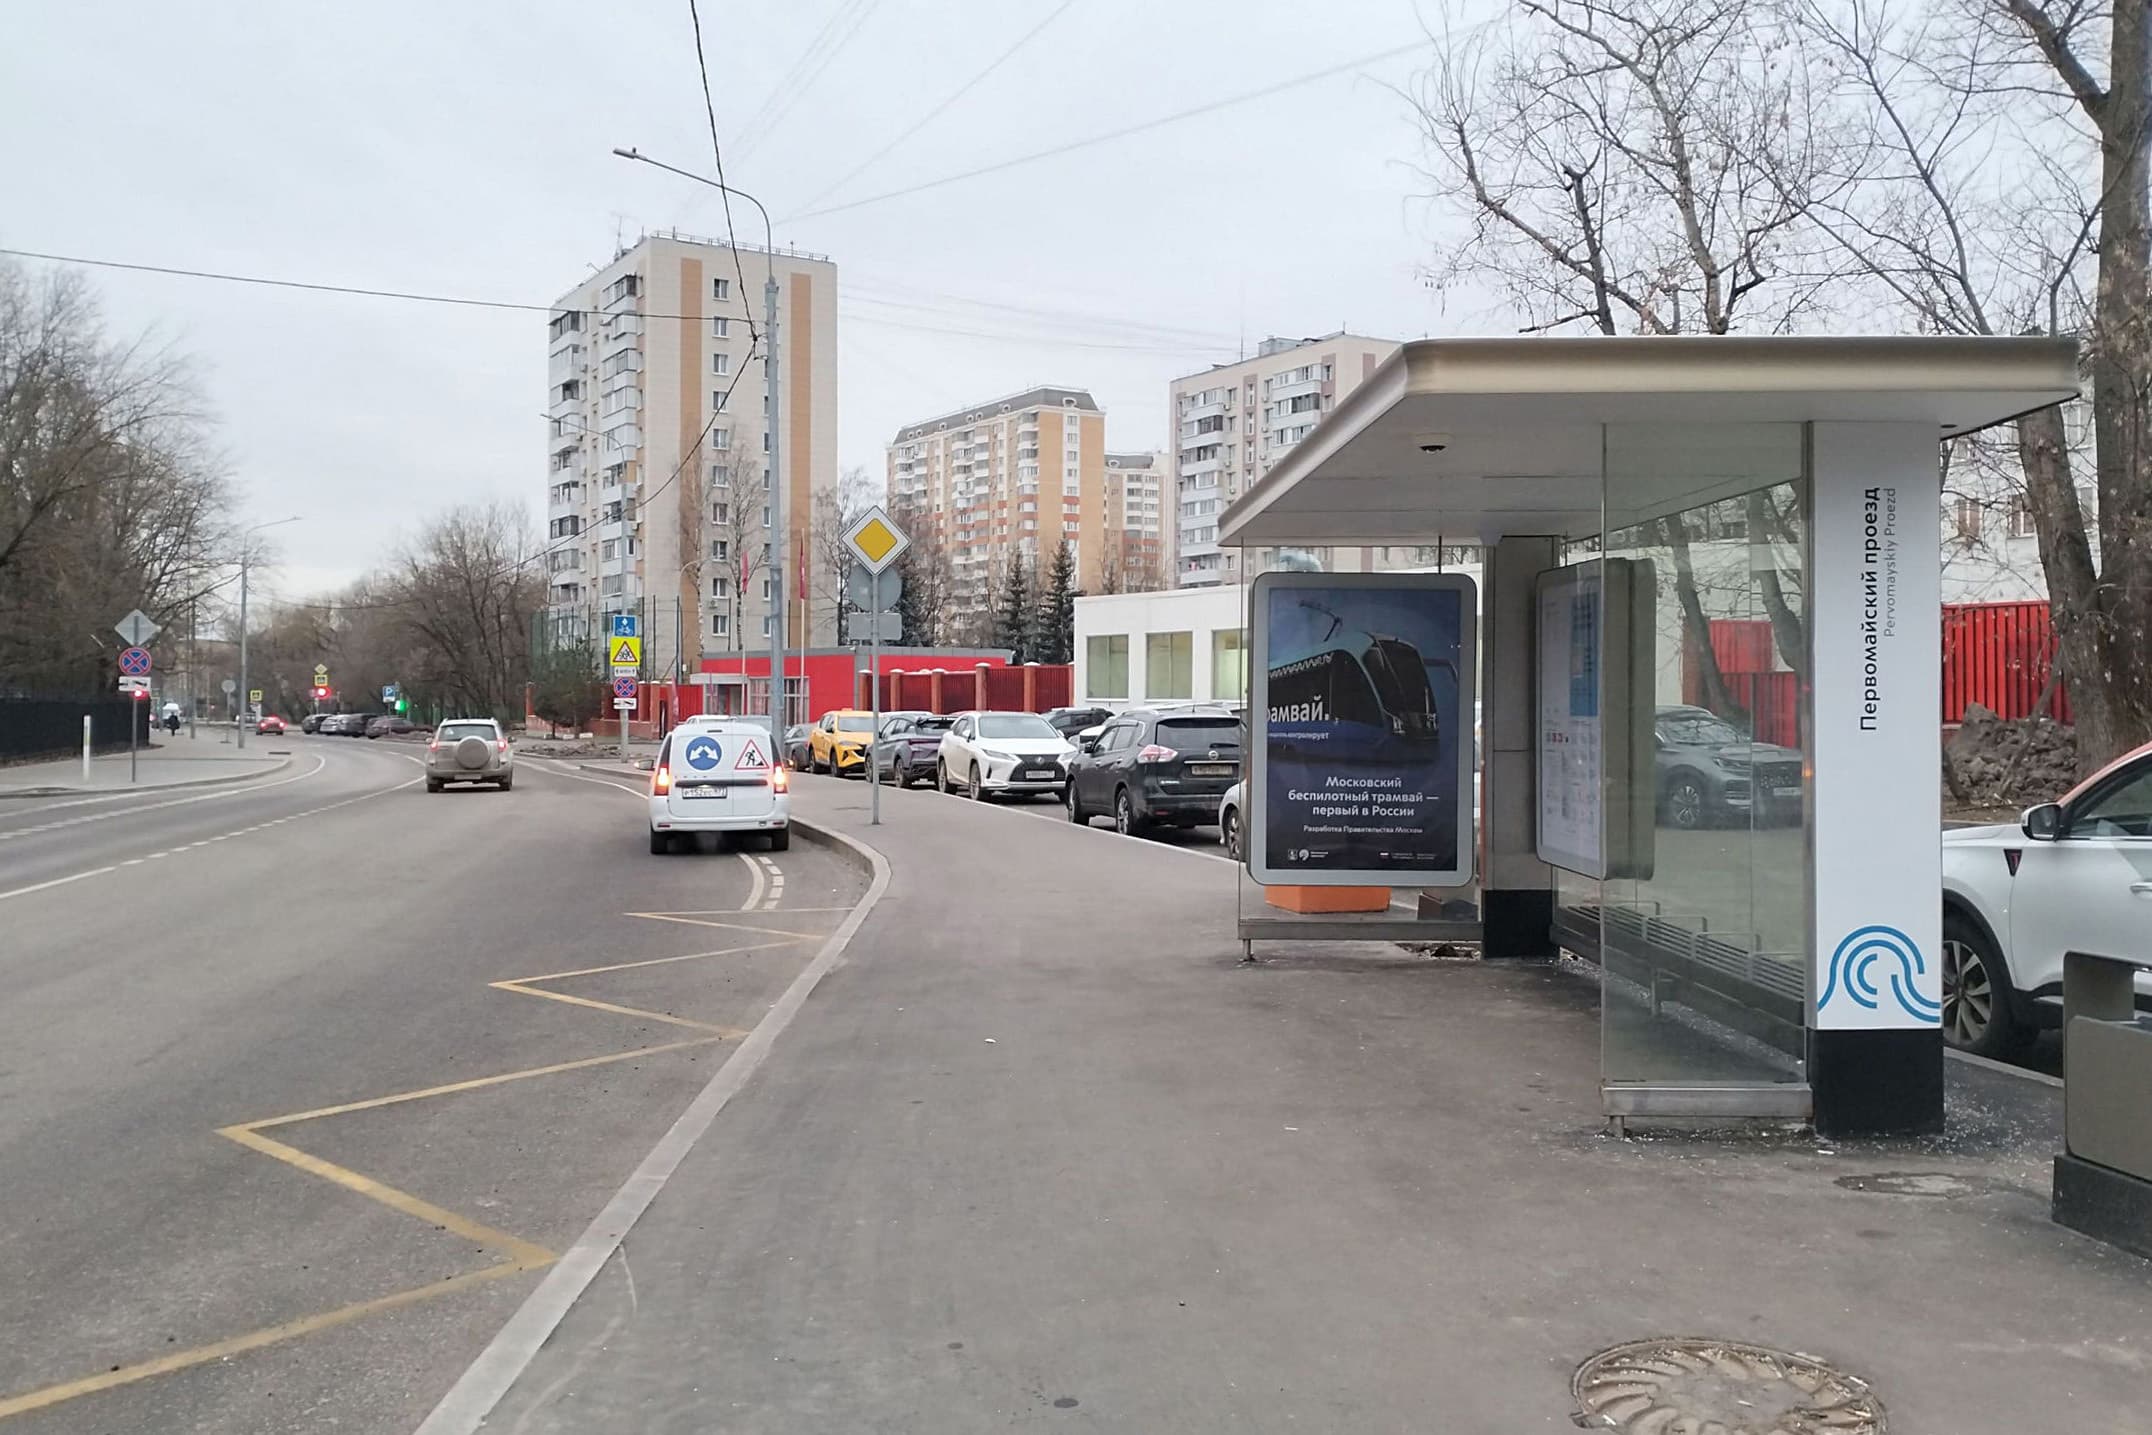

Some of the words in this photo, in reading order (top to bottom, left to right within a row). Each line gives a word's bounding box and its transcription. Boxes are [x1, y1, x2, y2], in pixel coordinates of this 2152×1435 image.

[1864, 487, 1881, 563] проезд
[1883, 488, 1896, 535] Proezd
[1883, 540, 1898, 637] Pervomayskiy
[1860, 570, 1881, 730] Первомайский
[1288, 789, 1369, 801] беспилотный
[1371, 791, 1423, 803] трамвай
[1326, 776, 1402, 788] Московский
[1312, 805, 1359, 817] первый
[1362, 807, 1369, 816] в
[1372, 805, 1415, 816] России
